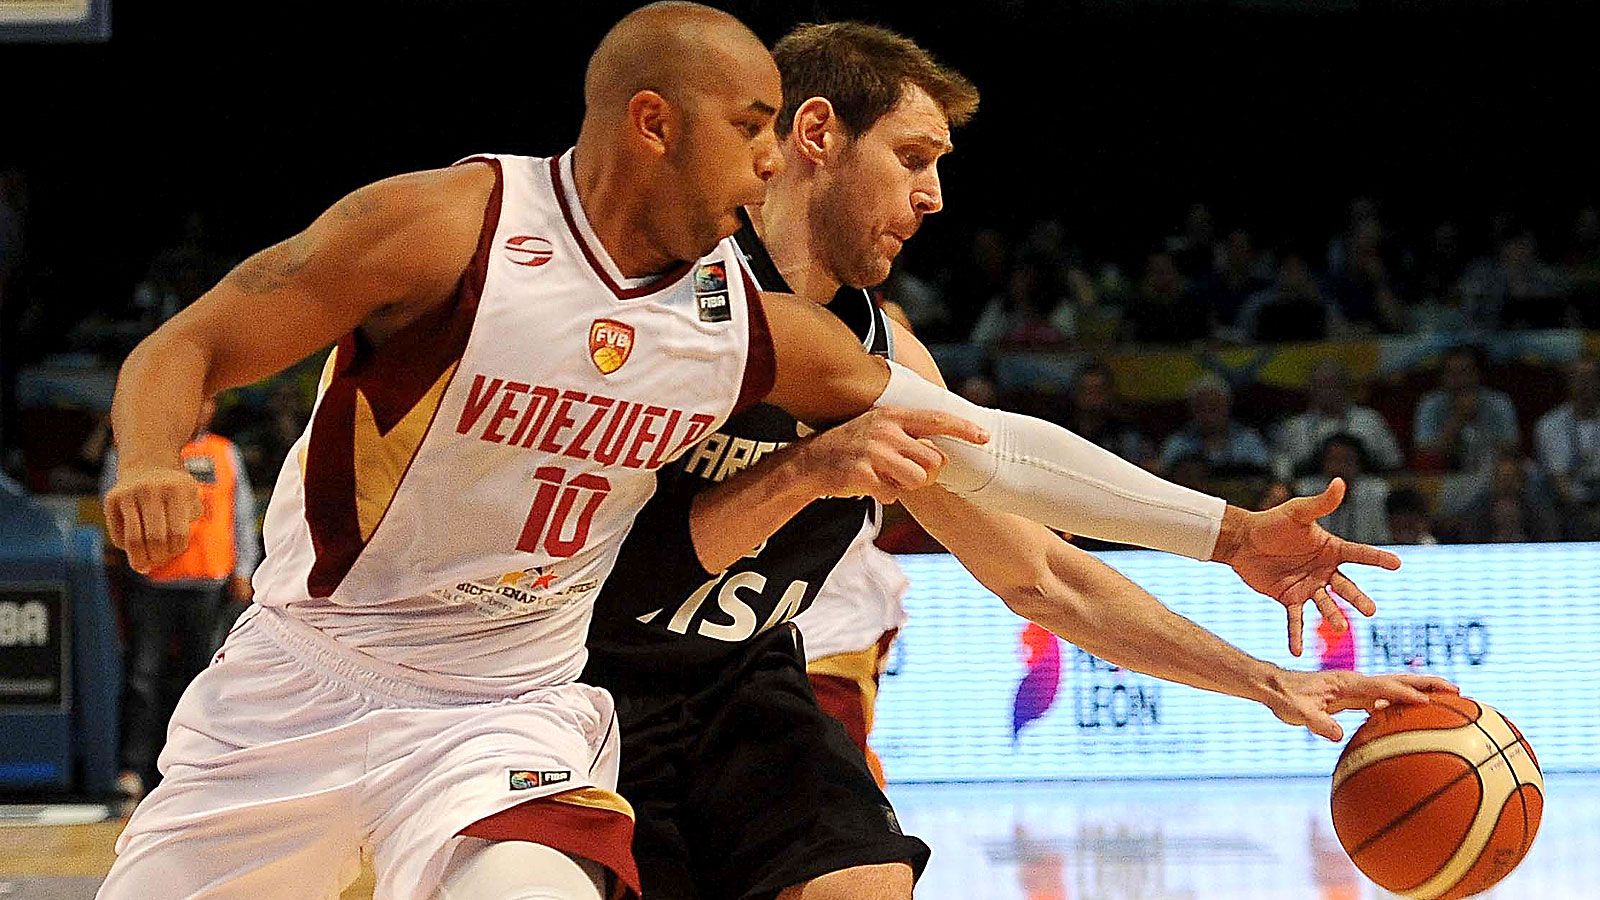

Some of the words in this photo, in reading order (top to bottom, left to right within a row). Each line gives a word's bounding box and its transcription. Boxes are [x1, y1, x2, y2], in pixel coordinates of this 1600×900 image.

[700, 295, 726, 309] FIBA
[595, 328, 629, 348] FVB
[515, 466, 611, 557] 10
[636, 570, 808, 642] ISA
